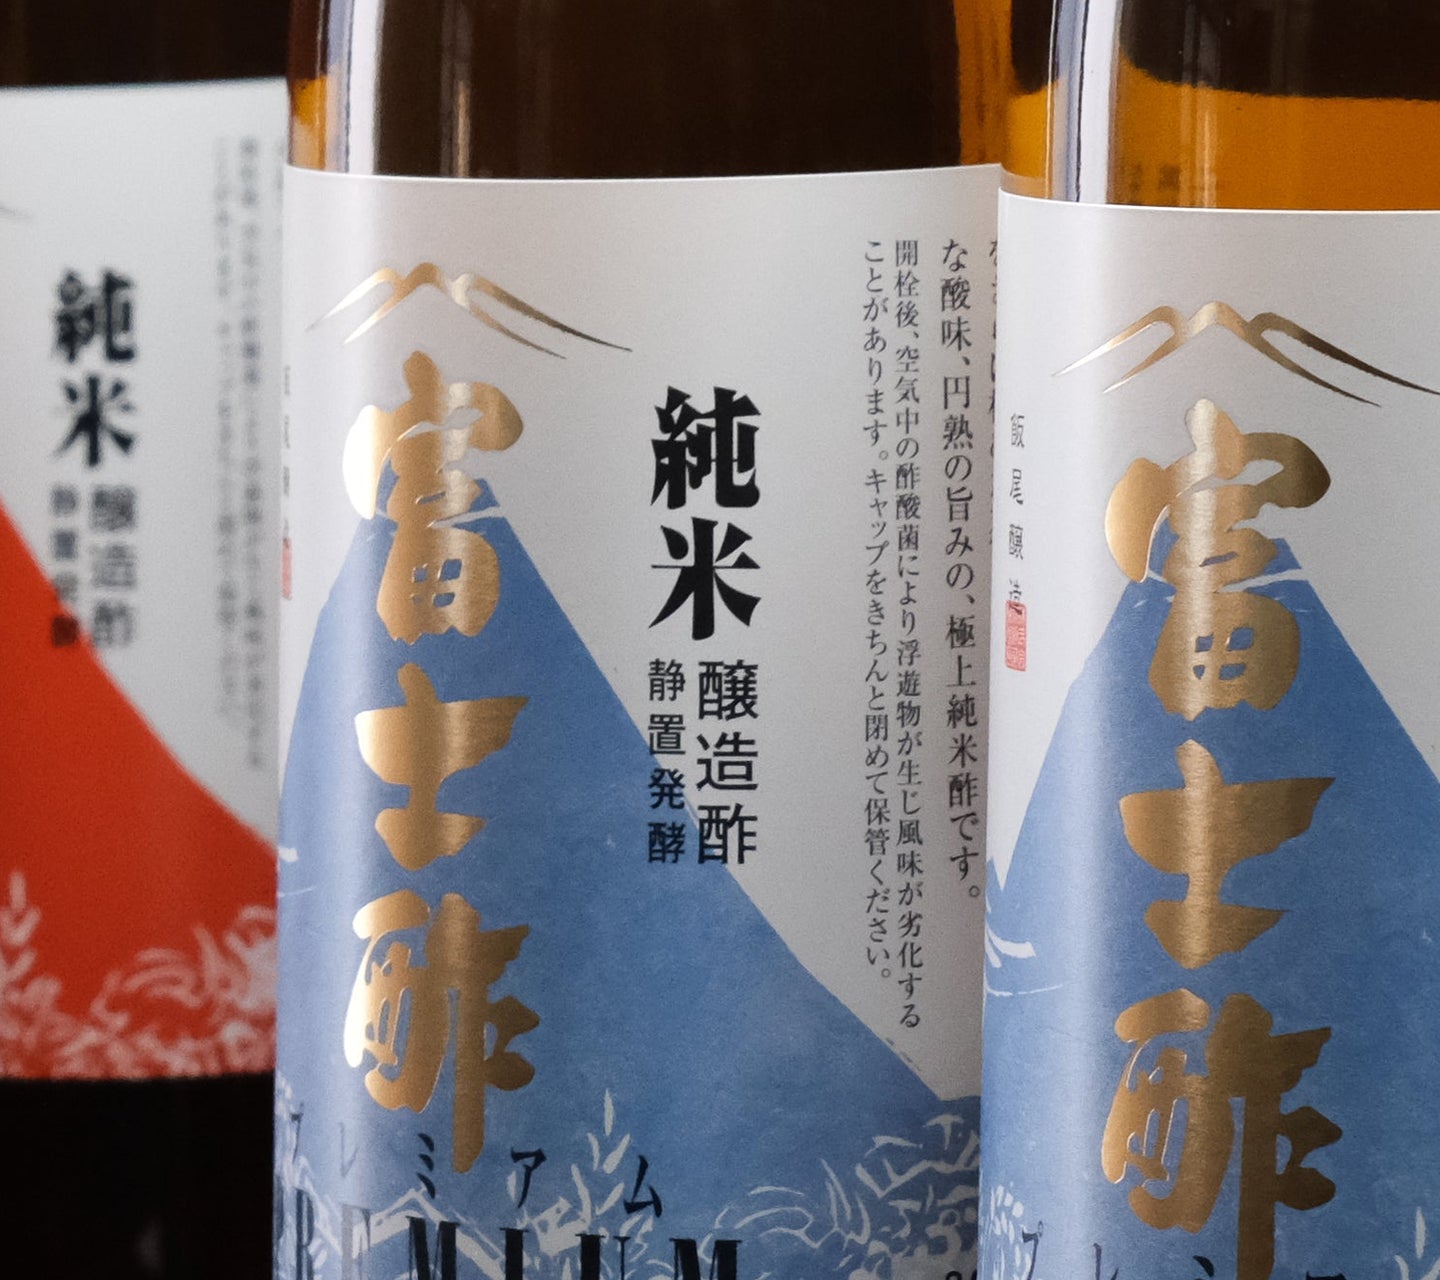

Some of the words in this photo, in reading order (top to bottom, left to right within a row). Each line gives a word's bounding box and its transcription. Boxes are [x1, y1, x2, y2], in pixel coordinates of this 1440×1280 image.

[53, 267, 137, 468] 純米
[648, 386, 763, 641] 純米
[940, 237, 981, 899] な酸味、円熟の旨みの、極上純米酢です。
[343, 350, 543, 1173] 富士酢
[646, 658, 688, 865] 静置発酵
[696, 658, 761, 868] 醸造酢
[862, 239, 892, 980] ことがあります。キャップをきちんと閉めて保管ください。
[894, 239, 924, 1029] 開栓後、空気中の酢酸菌により浮遊物が生じ風味が劣化する
